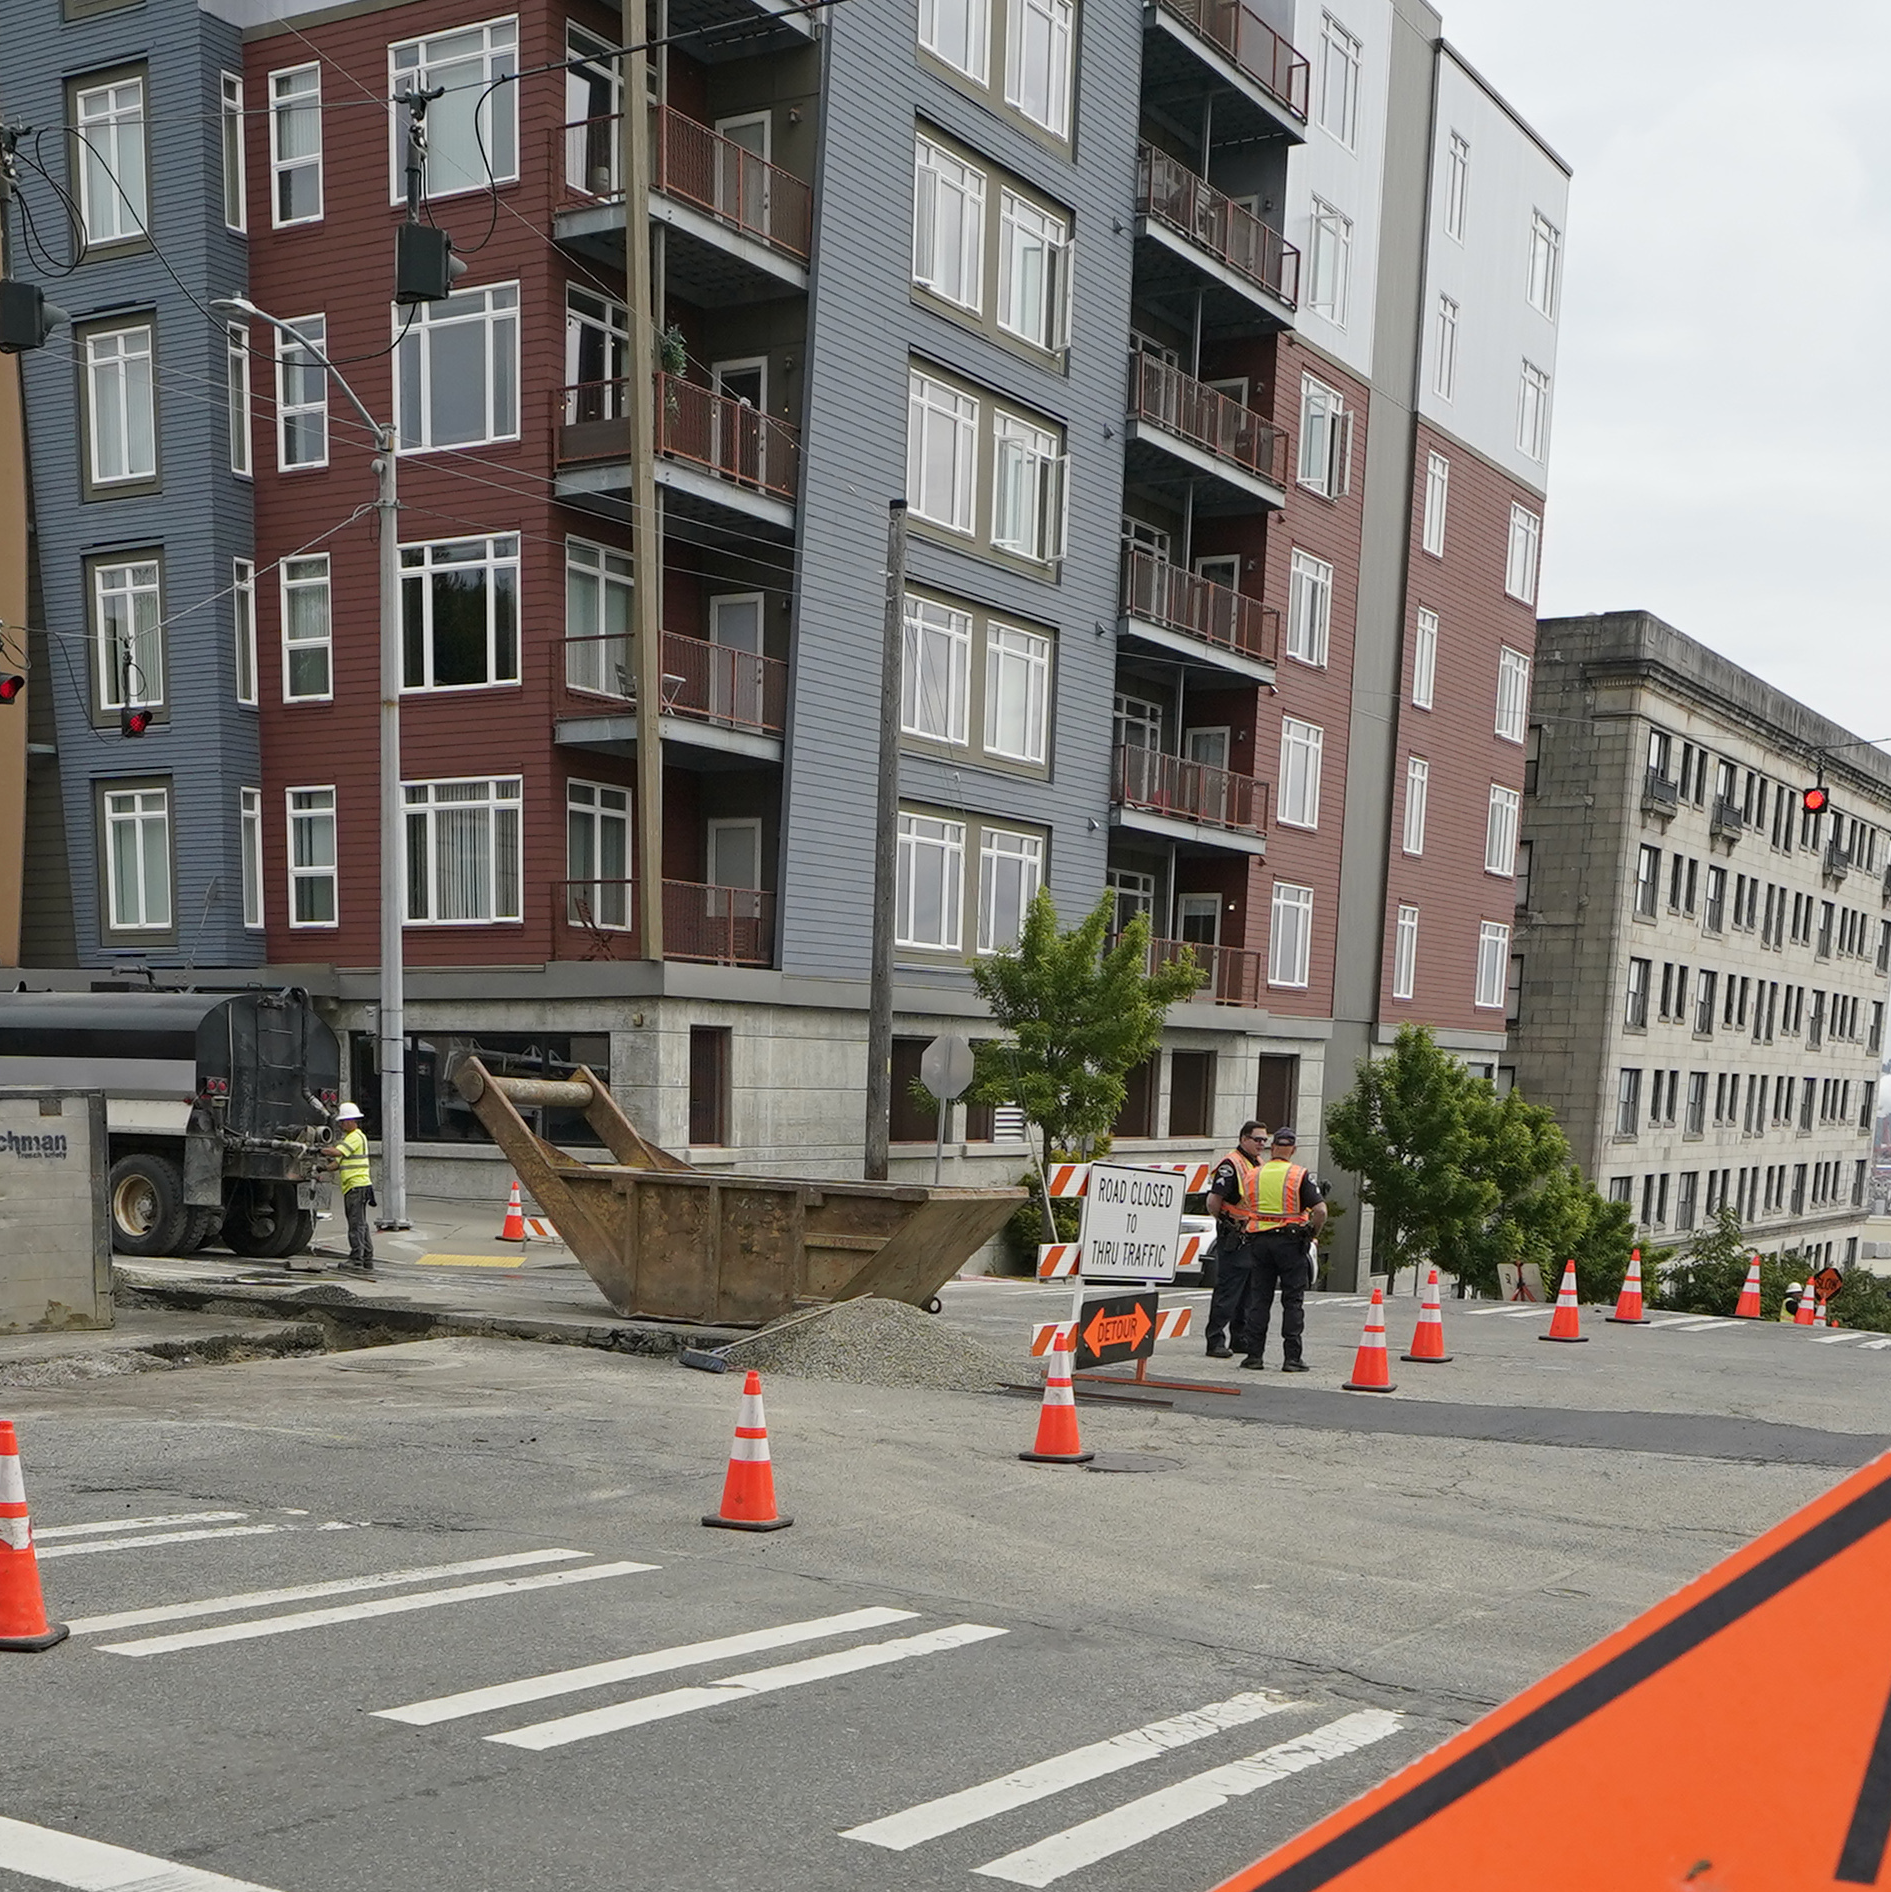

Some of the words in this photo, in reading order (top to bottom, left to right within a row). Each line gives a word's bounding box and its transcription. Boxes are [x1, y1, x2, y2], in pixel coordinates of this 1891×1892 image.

[1098, 1177, 1127, 1204] ROAD
[1130, 1181, 1174, 1208] CLOSED
[1126, 1213, 1138, 1234] TO
[1091, 1240, 1119, 1265] THRU
[1122, 1242, 1166, 1268] TRAFFIC
[1097, 1317, 1138, 1343] DETOUR
